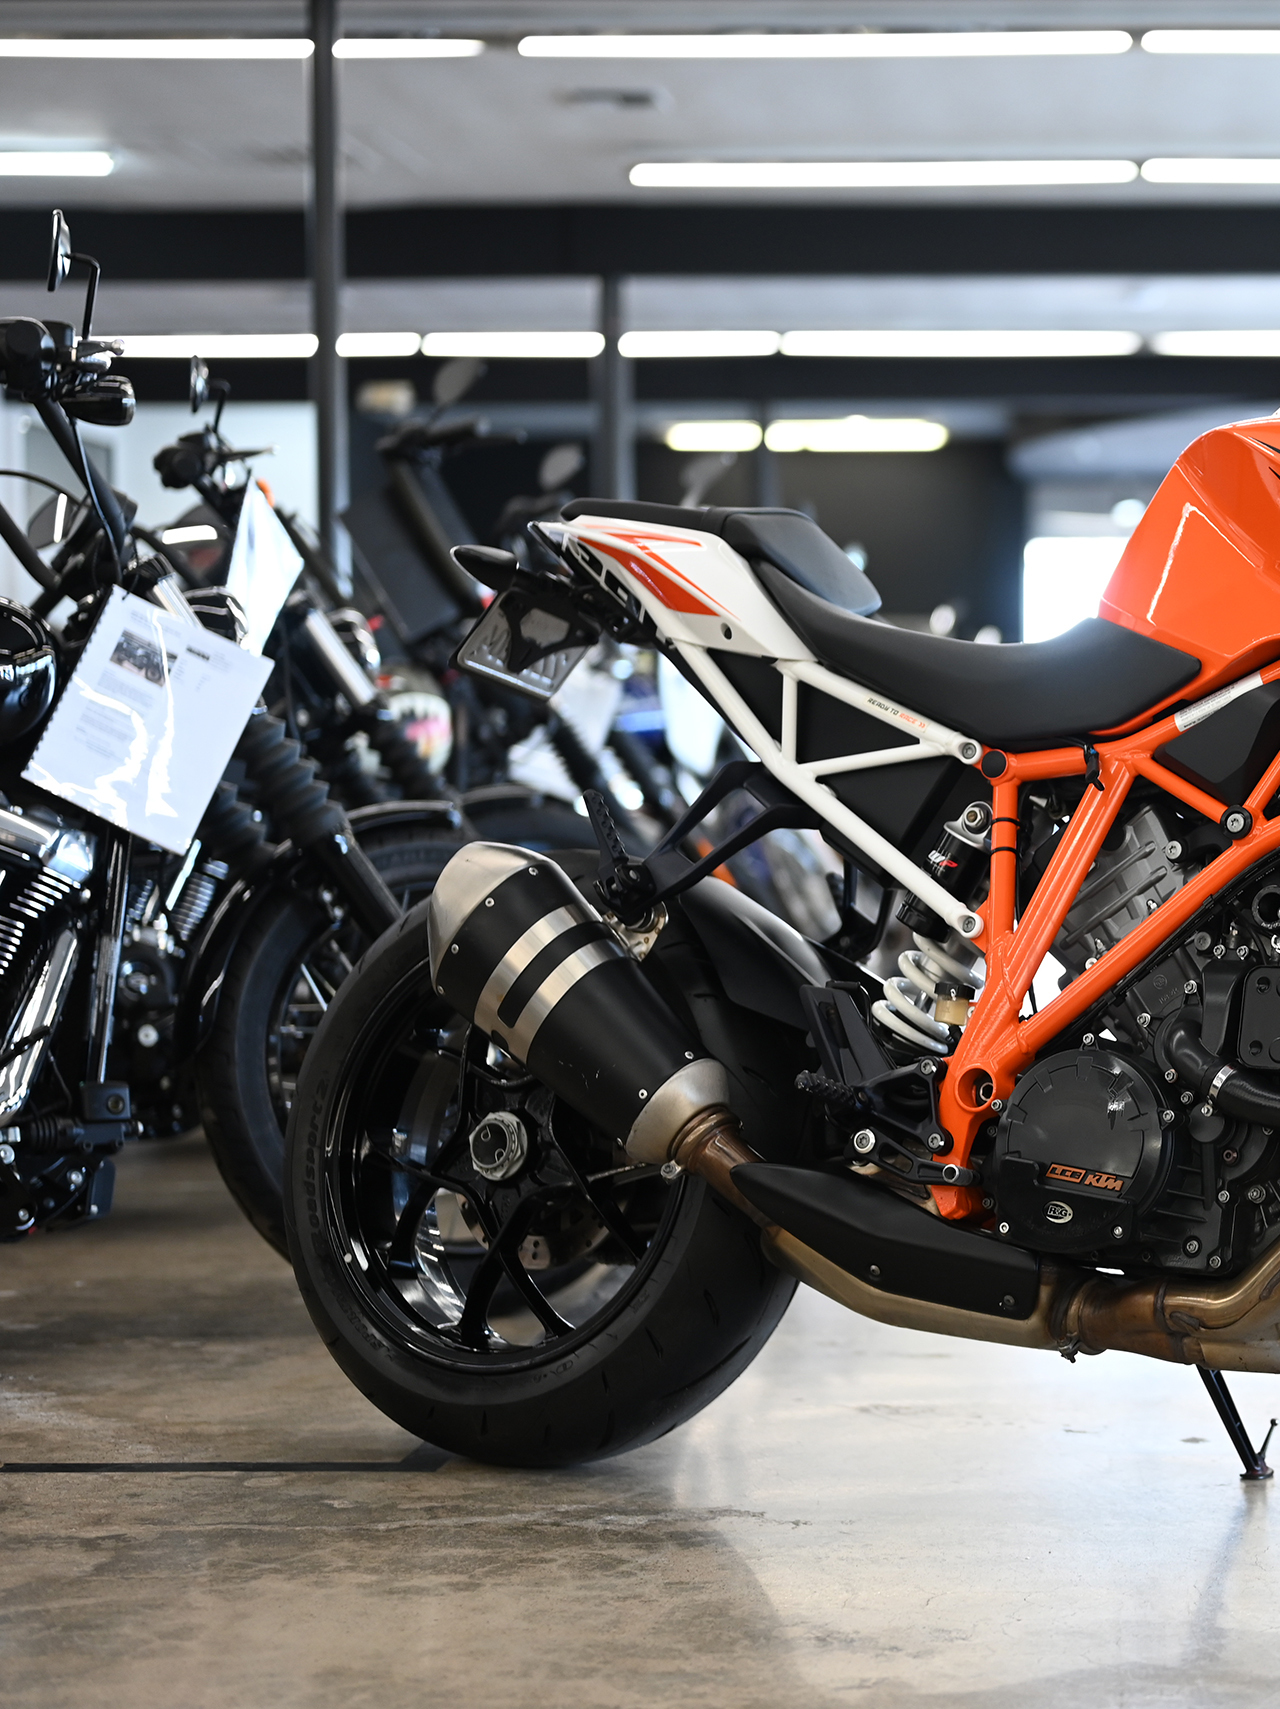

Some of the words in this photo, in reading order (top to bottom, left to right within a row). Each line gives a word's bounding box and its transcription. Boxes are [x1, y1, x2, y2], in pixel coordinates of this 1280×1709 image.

[867, 698, 890, 711] READY
[889, 707, 900, 716] TO
[899, 713, 918, 724] RACE
[927, 849, 959, 868] WP
[1084, 1172, 1124, 1191] KTM
[1047, 1205, 1069, 1218] R&G
